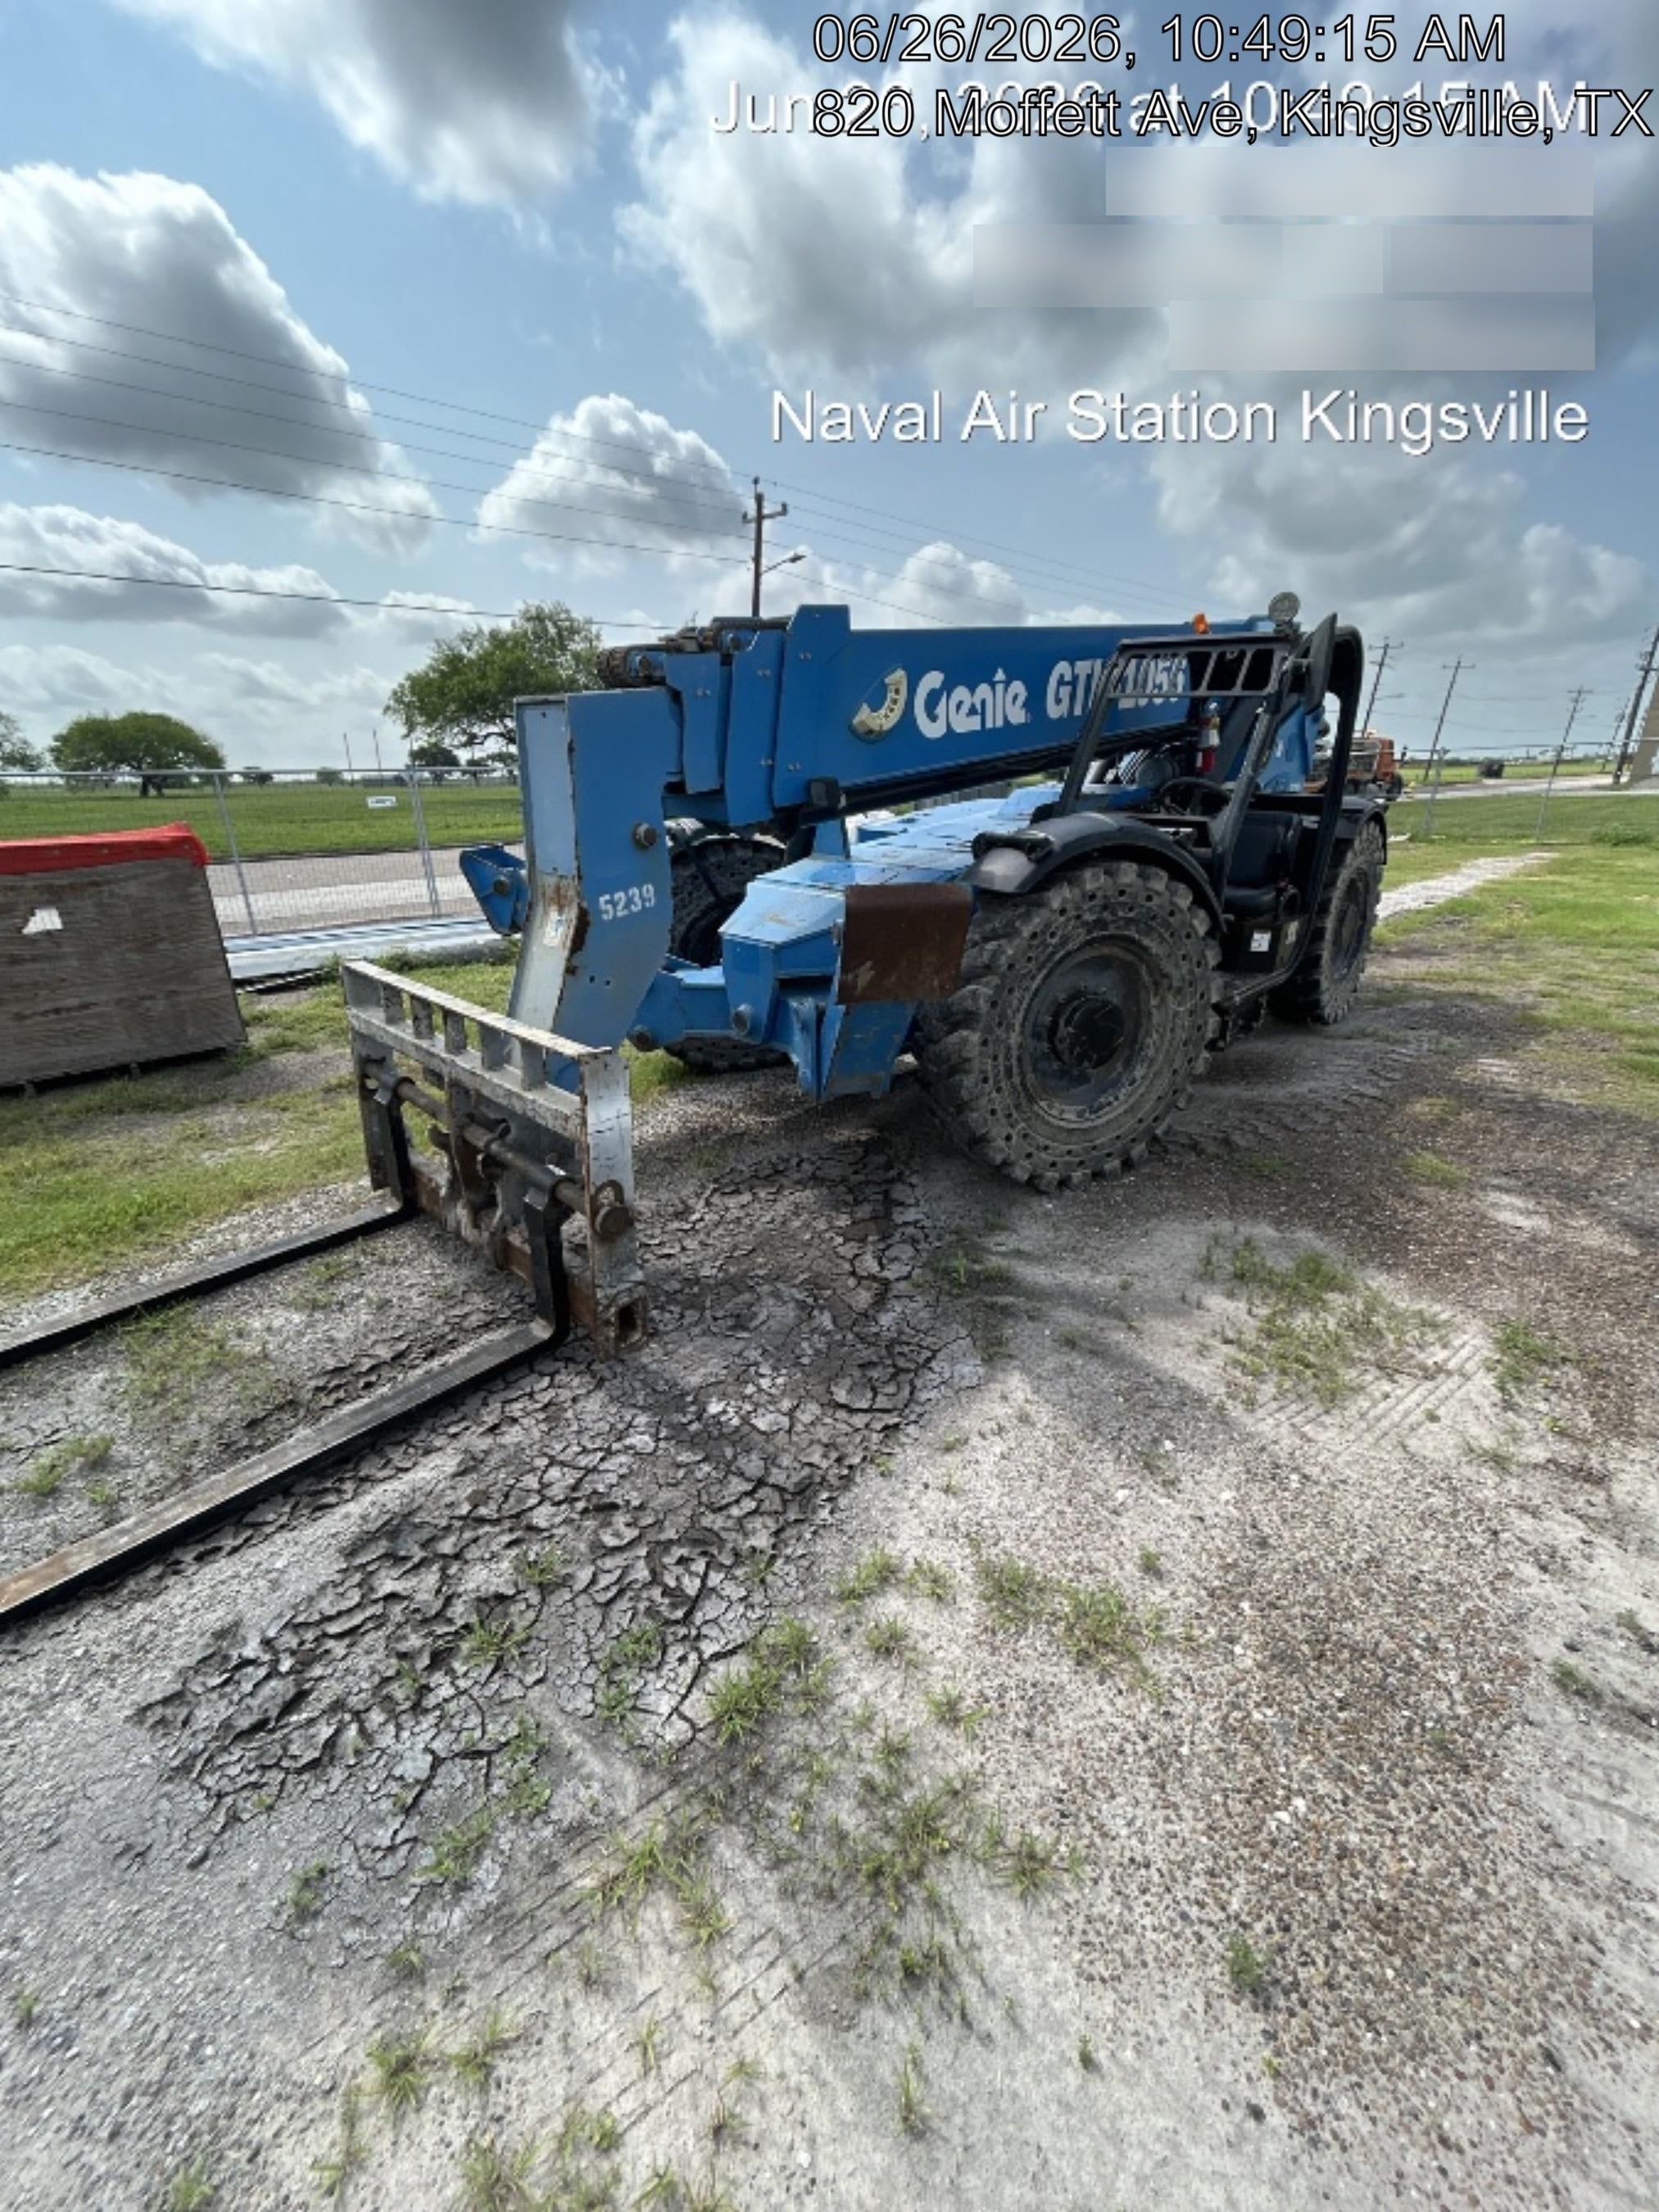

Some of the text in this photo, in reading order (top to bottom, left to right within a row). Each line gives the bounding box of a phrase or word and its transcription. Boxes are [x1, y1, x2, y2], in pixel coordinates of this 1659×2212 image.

[913, 668, 1027, 739] Genie
[1046, 655, 1189, 719] GT1056
[599, 883, 656, 921] 5239
